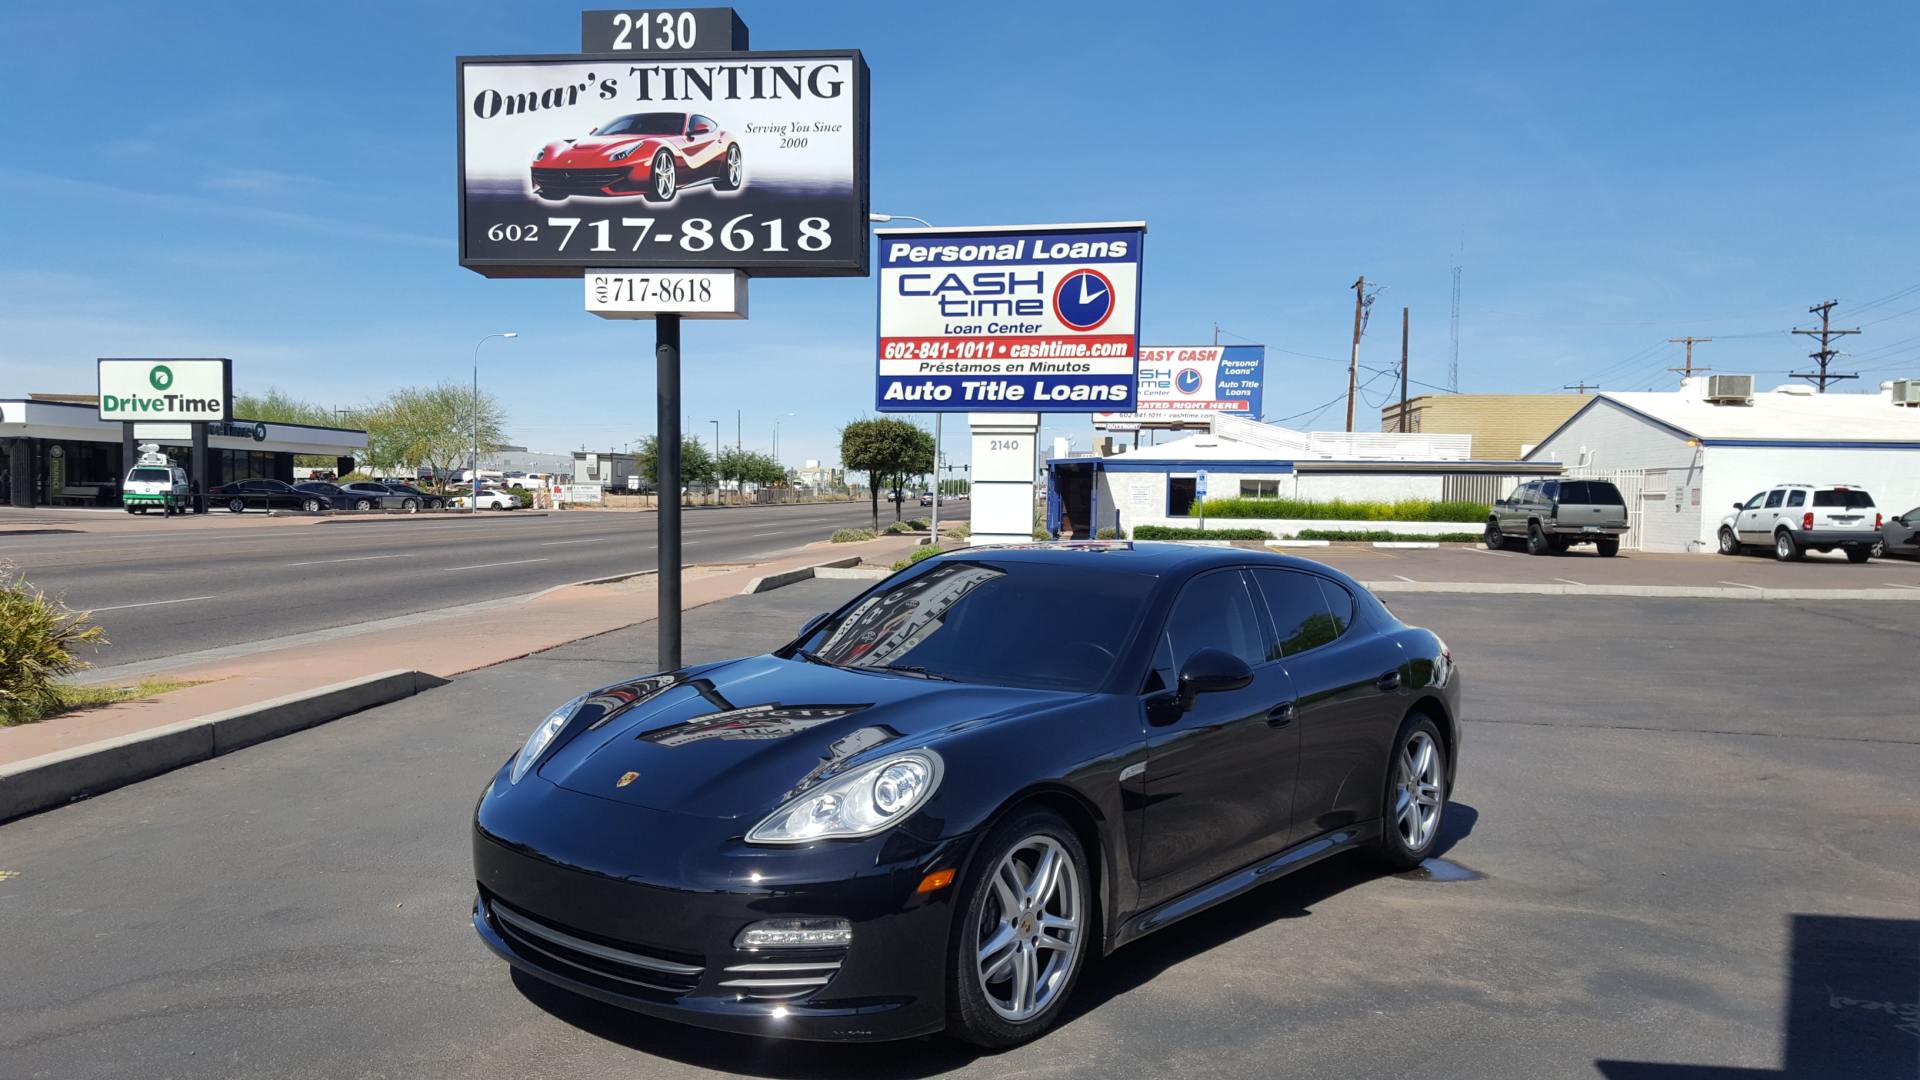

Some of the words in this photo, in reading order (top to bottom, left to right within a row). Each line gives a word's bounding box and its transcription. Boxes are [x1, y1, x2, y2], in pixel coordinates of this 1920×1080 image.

[612, 11, 697, 50] 2130
[473, 72, 618, 120] Omar's
[629, 64, 844, 102] TINTING
[745, 122, 787, 136] Serving
[790, 122, 811, 134] You
[813, 121, 842, 134] Since
[779, 138, 809, 149] 2000
[487, 224, 539, 243] 602
[547, 214, 833, 253] 717-8618
[889, 240, 1026, 263] Personal
[1032, 240, 1128, 260] Loans
[596, 276, 609, 304] 602
[613, 277, 712, 304] 717-8618
[899, 271, 1044, 297] CASH
[938, 294, 1044, 318] time
[944, 323, 983, 335] Loan
[987, 322, 1042, 334] Center
[884, 342, 995, 359] 602-841-1011
[1009, 341, 1128, 357] cashtime.com
[1139, 350, 1176, 362] EASY
[1178, 350, 1218, 362] CASH
[919, 361, 1001, 373] Préstamos
[1005, 364, 1024, 372] en
[1028, 361, 1091, 372] Minutos
[1221, 359, 1259, 367] Personal
[1139, 369, 1171, 379] SH
[884, 382, 952, 401] Auto
[961, 382, 1025, 401] Title
[1032, 381, 1128, 400] Loans
[1241, 380, 1259, 388] Title
[103, 394, 220, 412] DriveTime
[1138, 401, 1170, 410] CATED
[1173, 401, 1206, 410] RIGHT
[1209, 401, 1239, 410] HERE
[990, 440, 1019, 450] 2140
